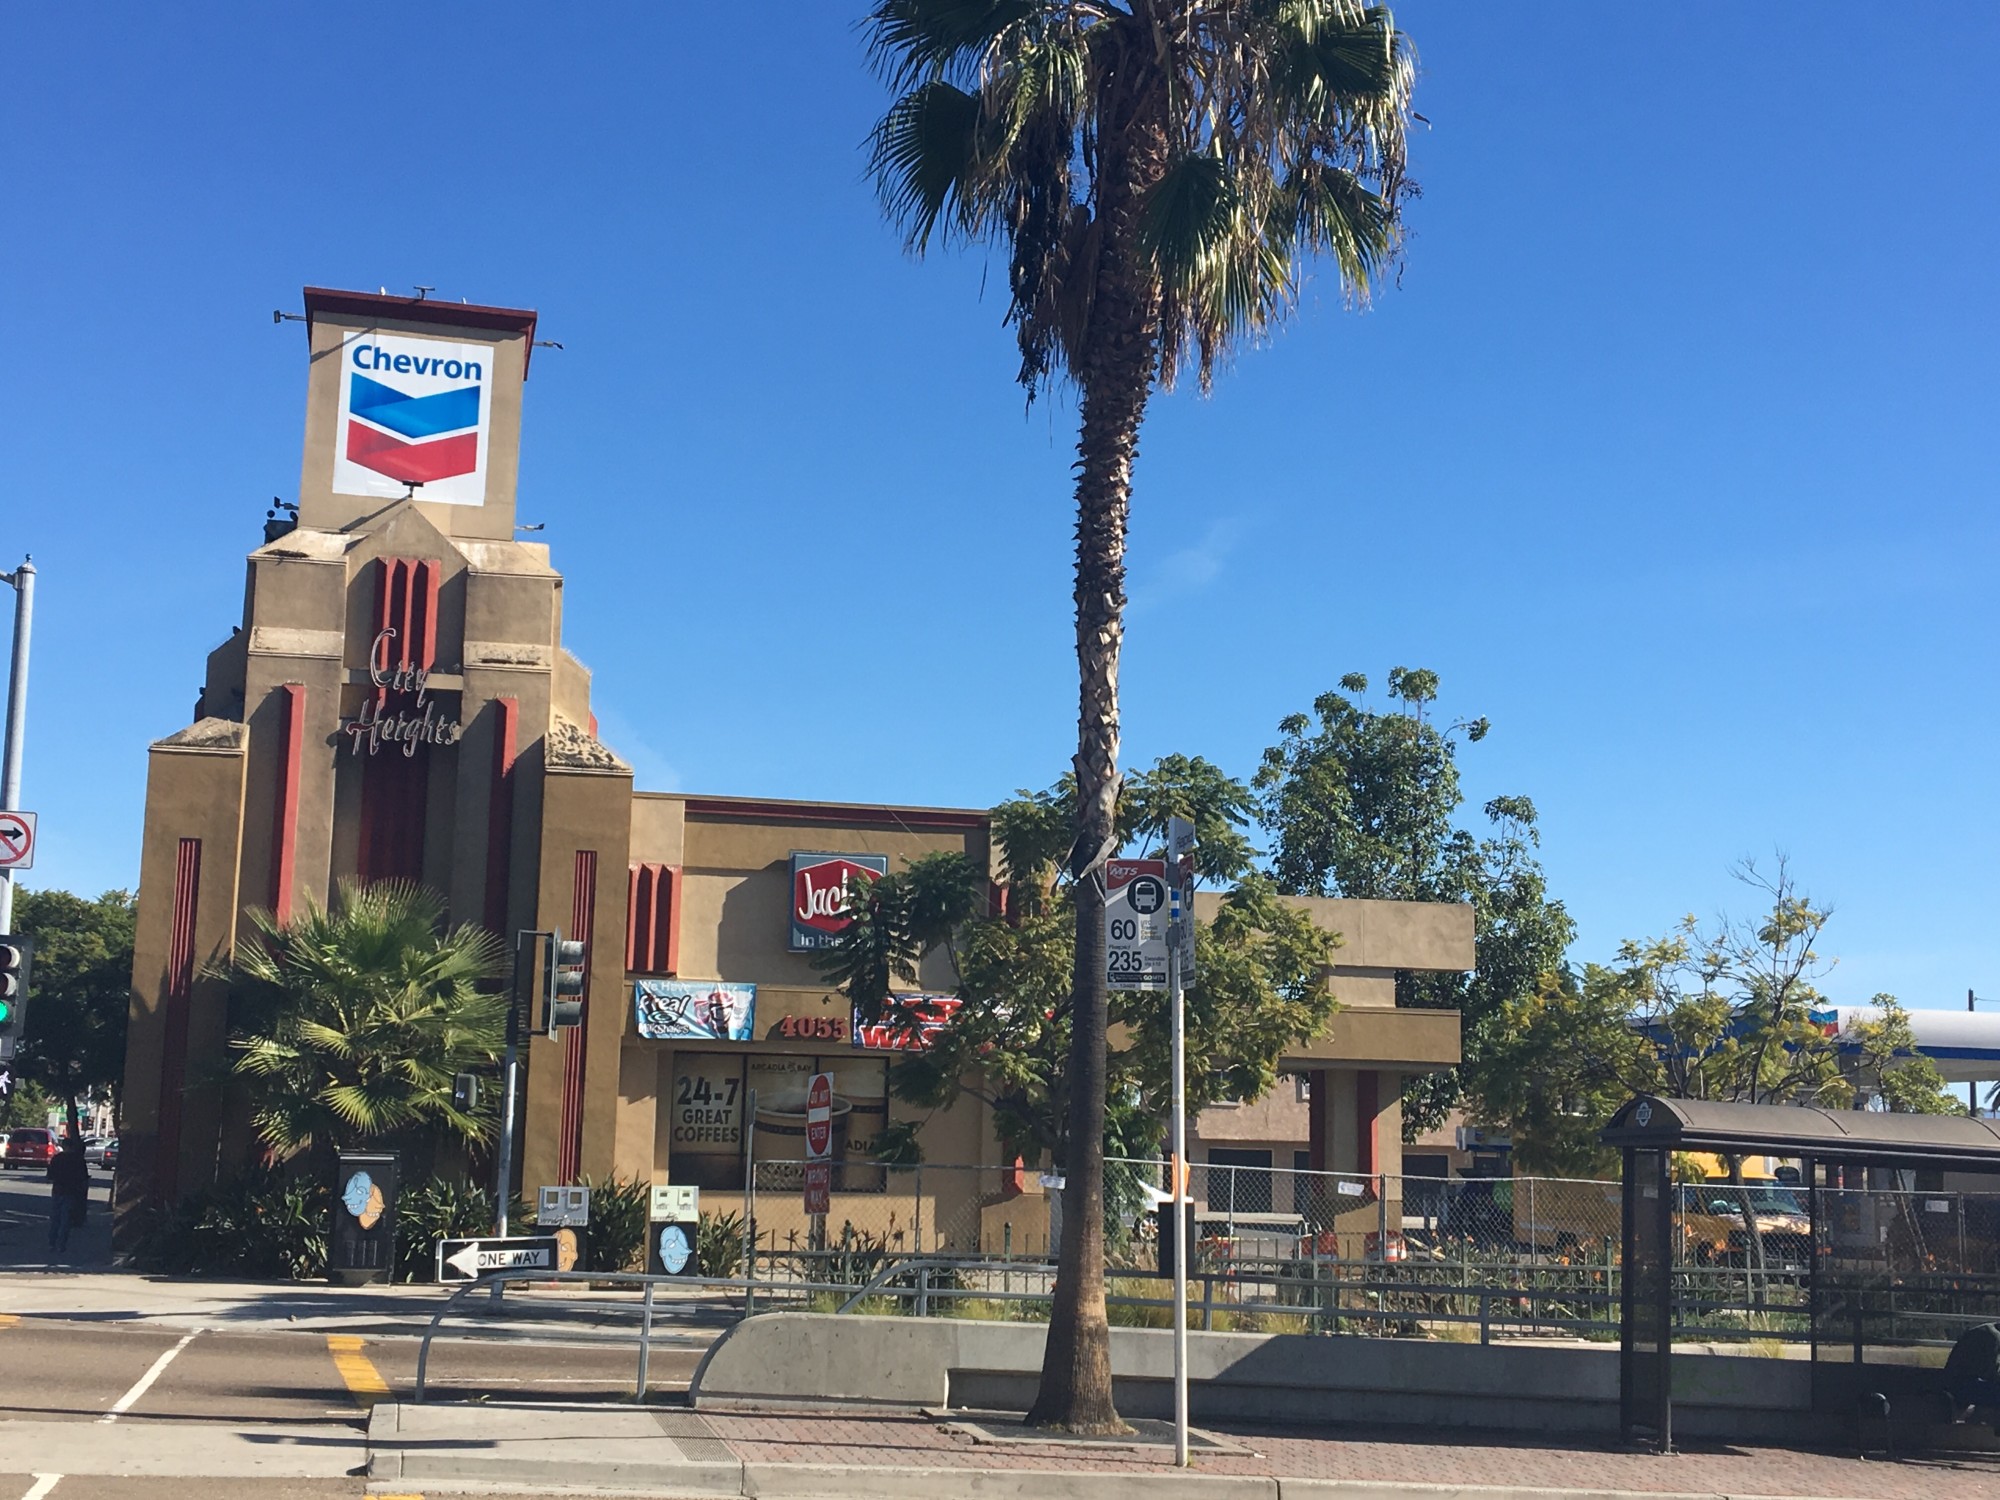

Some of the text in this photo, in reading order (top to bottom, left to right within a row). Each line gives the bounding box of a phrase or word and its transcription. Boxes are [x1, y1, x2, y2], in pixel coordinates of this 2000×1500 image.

[352, 344, 482, 381] Chevron
[370, 627, 428, 708] City
[346, 699, 457, 757] Heights
[1109, 866, 1138, 877] MTS
[1110, 919, 1137, 940] 60
[801, 934, 844, 947] in the
[1108, 950, 1143, 972] 235
[661, 981, 691, 992] Have
[779, 1014, 849, 1039] 4055
[677, 1075, 740, 1106] 24-7
[810, 1089, 830, 1104] DO NOT
[682, 1109, 732, 1125] GREAT
[674, 1126, 739, 1143] COFFEES
[811, 1126, 827, 1140] ENTER
[807, 1168, 828, 1184] WRONG
[477, 1251, 540, 1267] ONE WAY
